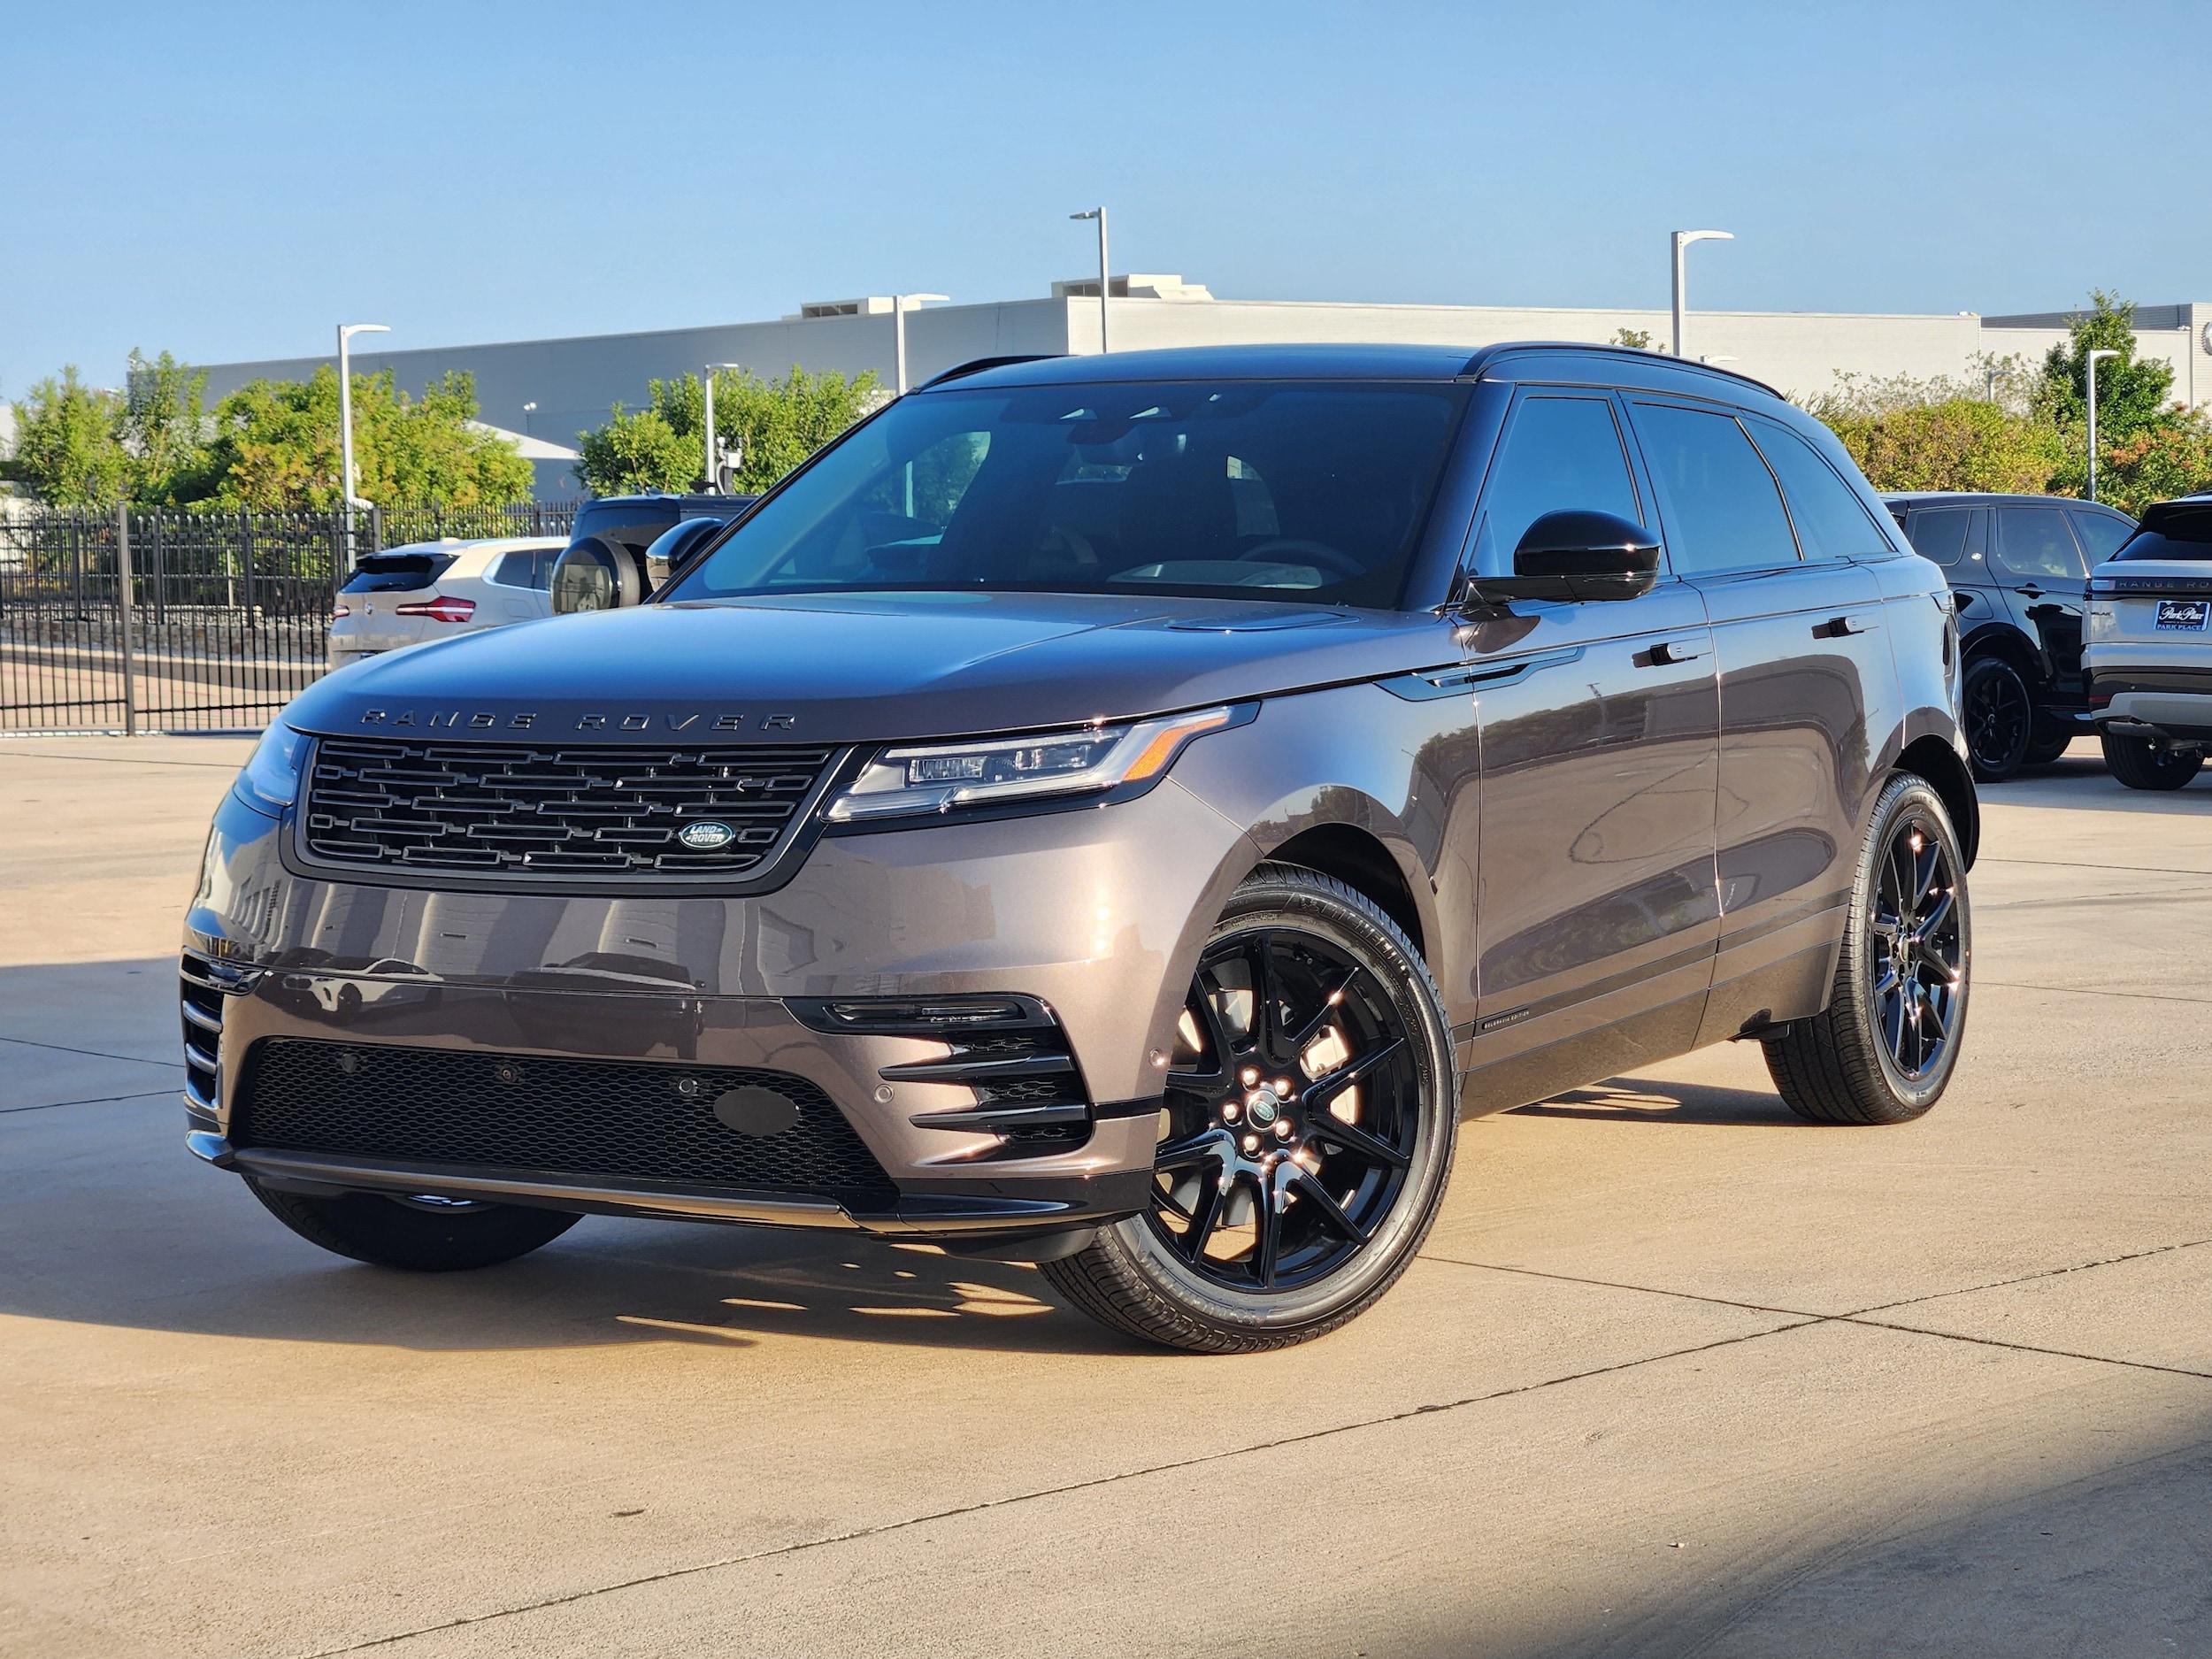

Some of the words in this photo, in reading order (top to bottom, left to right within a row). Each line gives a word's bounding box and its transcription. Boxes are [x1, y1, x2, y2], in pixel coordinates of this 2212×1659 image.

[359, 708, 537, 729] RANGE
[575, 713, 796, 732] ROVER
[689, 826, 718, 834] LAND
[689, 833, 726, 842] ROVER
